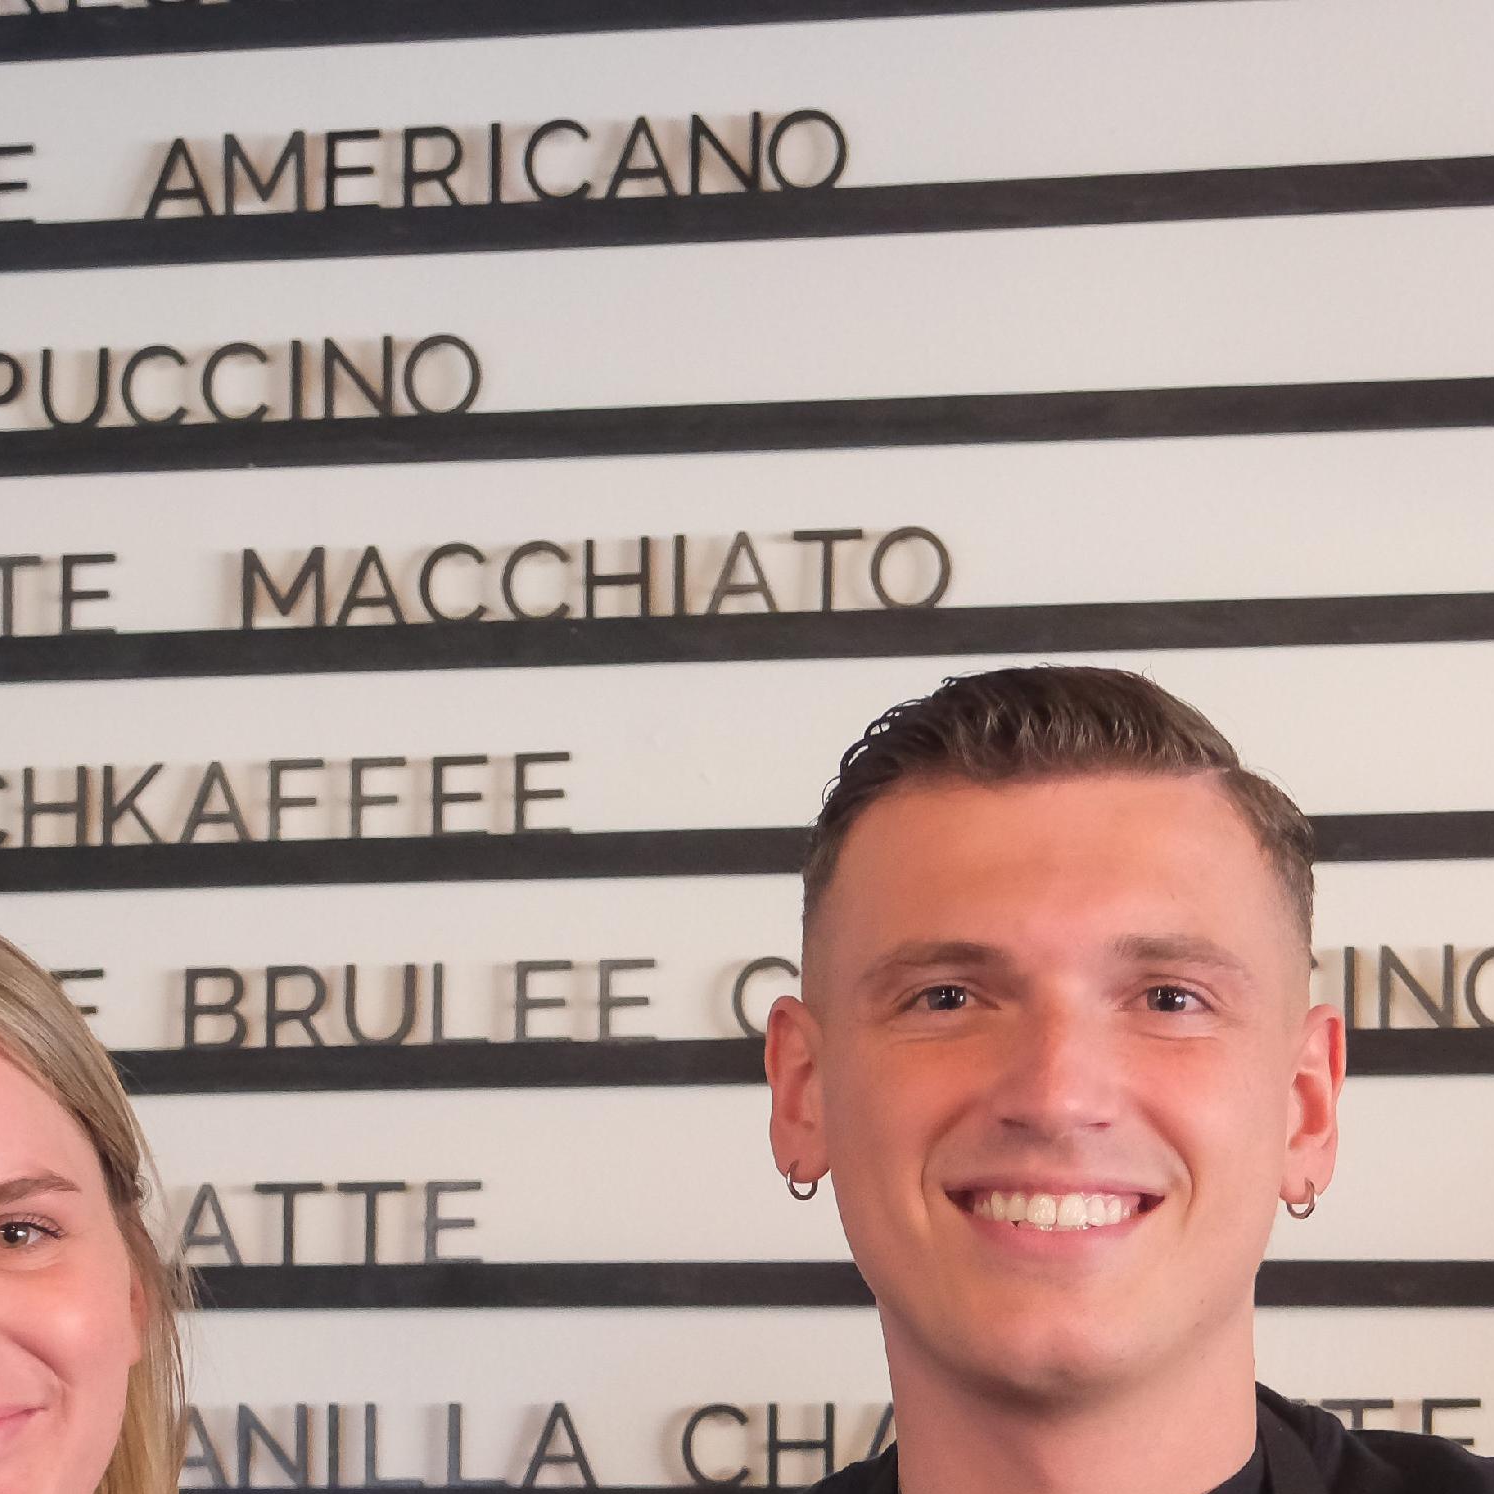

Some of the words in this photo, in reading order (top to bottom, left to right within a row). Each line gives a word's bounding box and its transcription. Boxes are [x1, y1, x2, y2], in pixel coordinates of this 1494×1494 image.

[143, 108, 848, 219] AMERICANO
[242, 526, 951, 629] MACCHIATO
[183, 957, 658, 1050] BRULEE
[179, 1180, 484, 1267] ATTE
[180, 1402, 597, 1489] ANILLA
